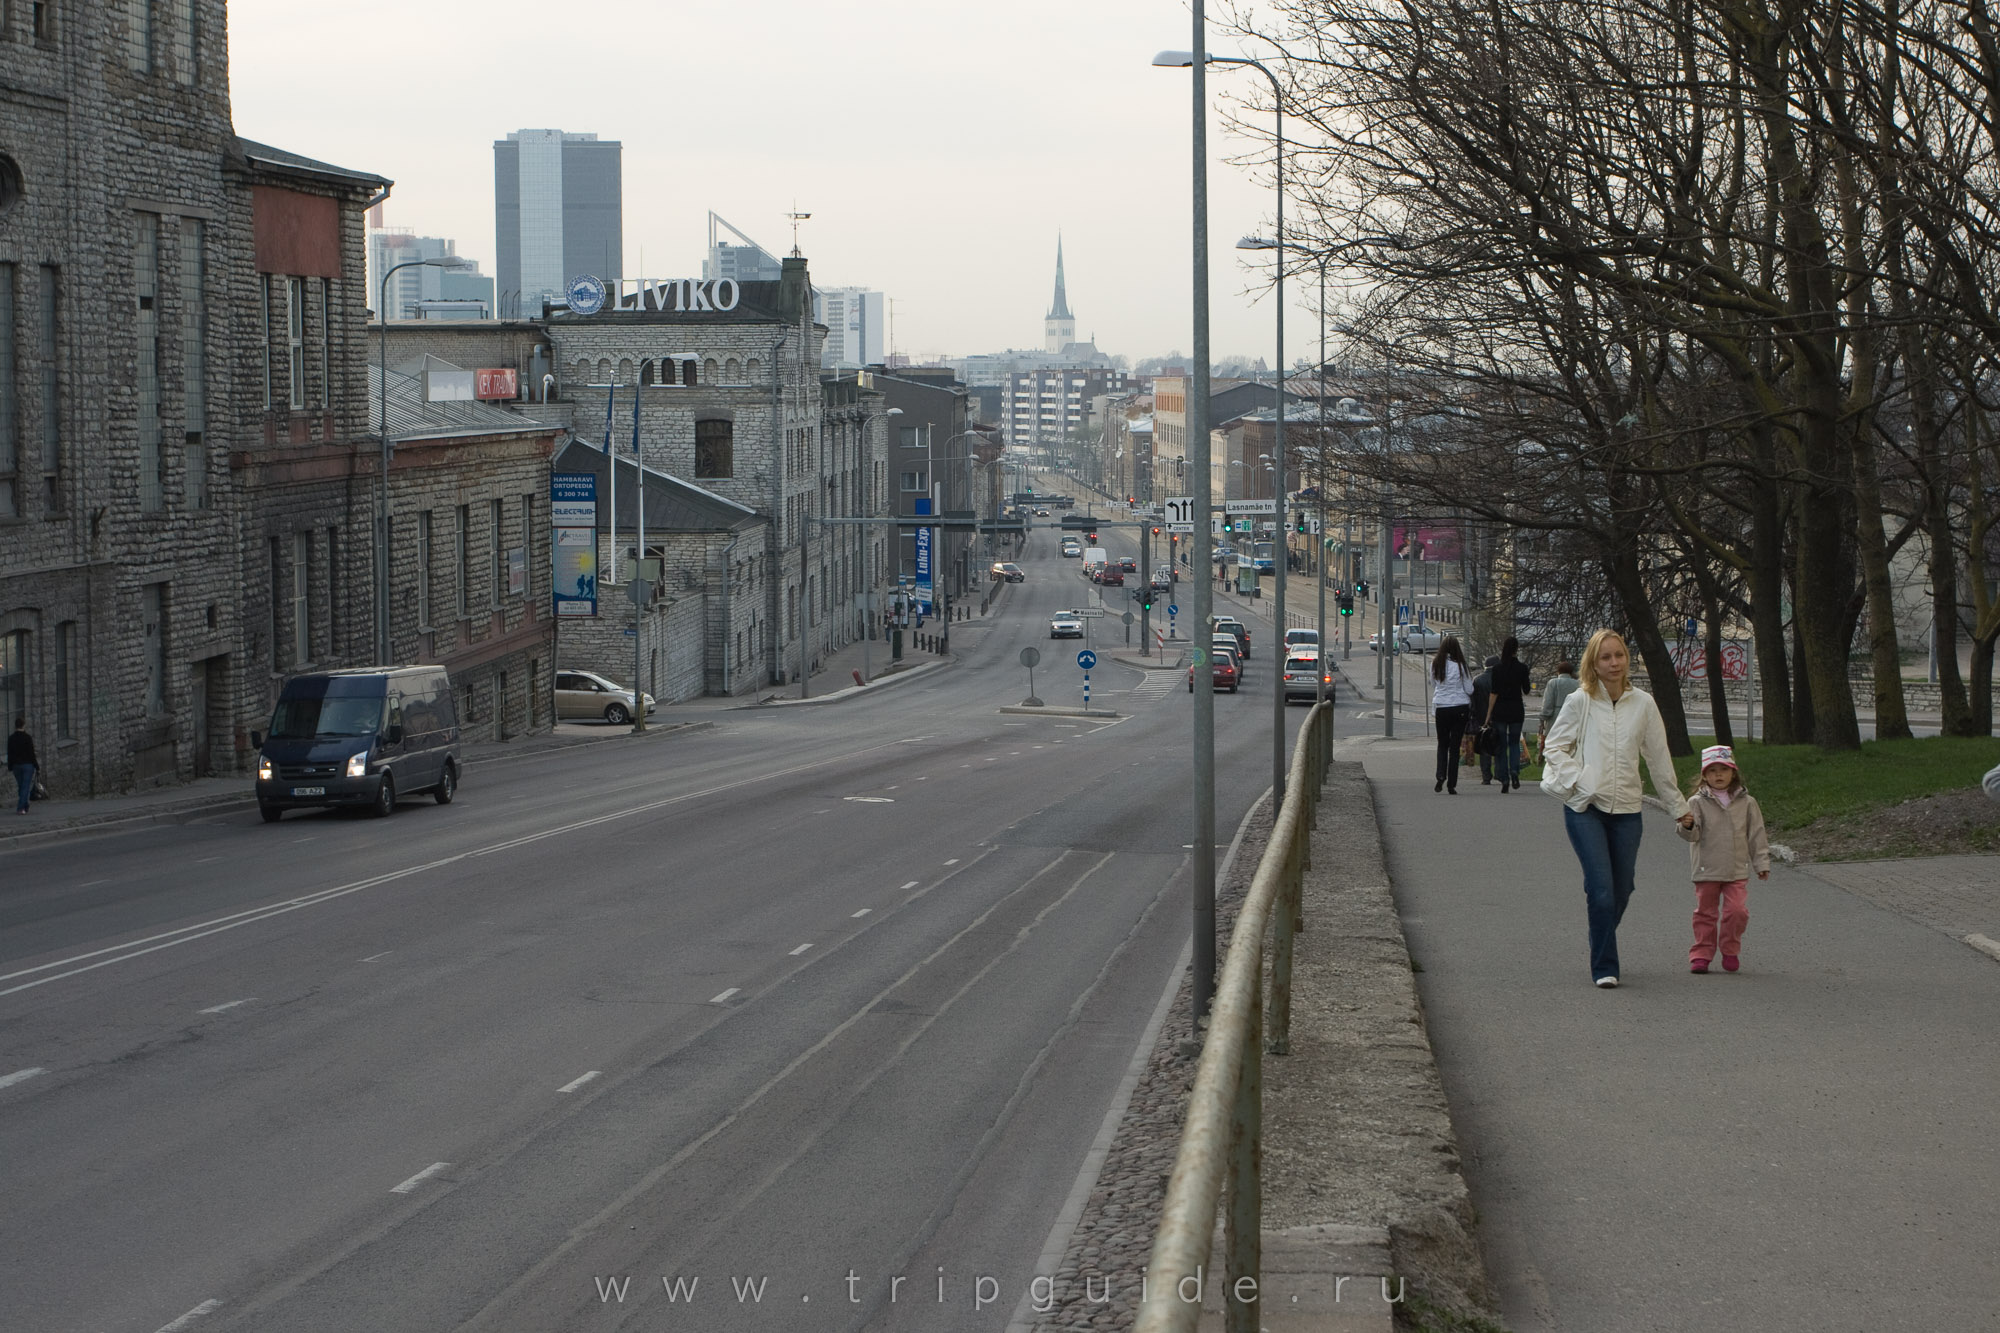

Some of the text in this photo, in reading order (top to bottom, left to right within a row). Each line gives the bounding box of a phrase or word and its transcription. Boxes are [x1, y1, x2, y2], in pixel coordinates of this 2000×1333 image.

[612, 277, 740, 311] LIVIKO
[478, 374, 492, 395] KEK
[1227, 503, 1264, 511] Lasnamäe
